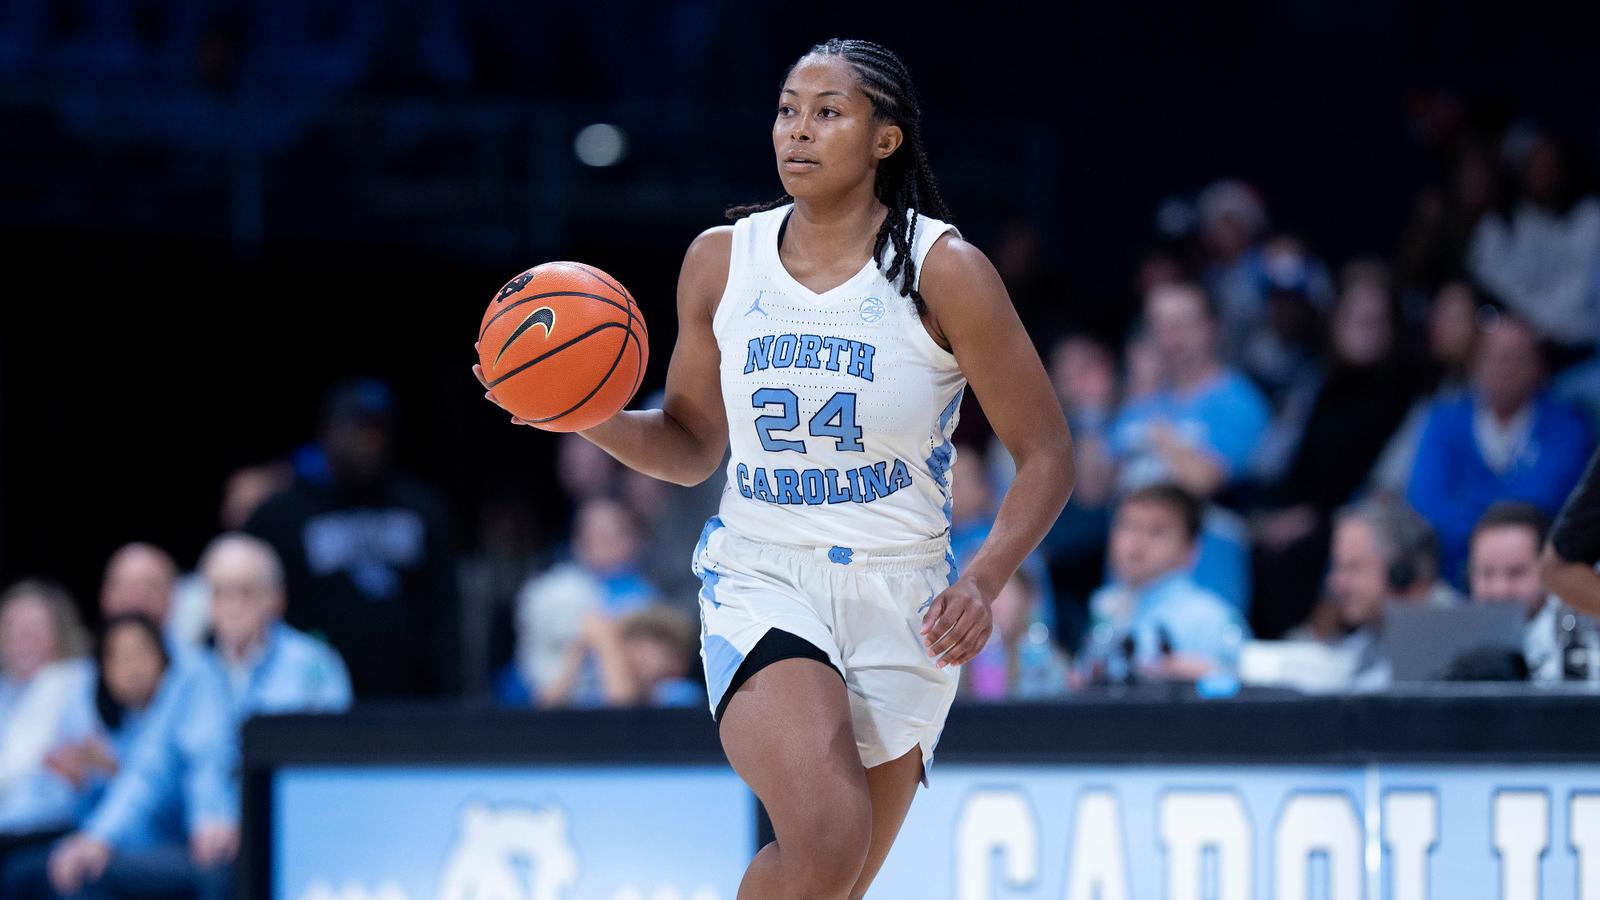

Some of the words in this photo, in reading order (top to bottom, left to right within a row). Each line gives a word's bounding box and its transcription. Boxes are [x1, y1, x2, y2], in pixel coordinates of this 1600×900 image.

[744, 334, 876, 382] NORTH
[751, 387, 865, 454] 24
[736, 458, 912, 505] CAROLINA
